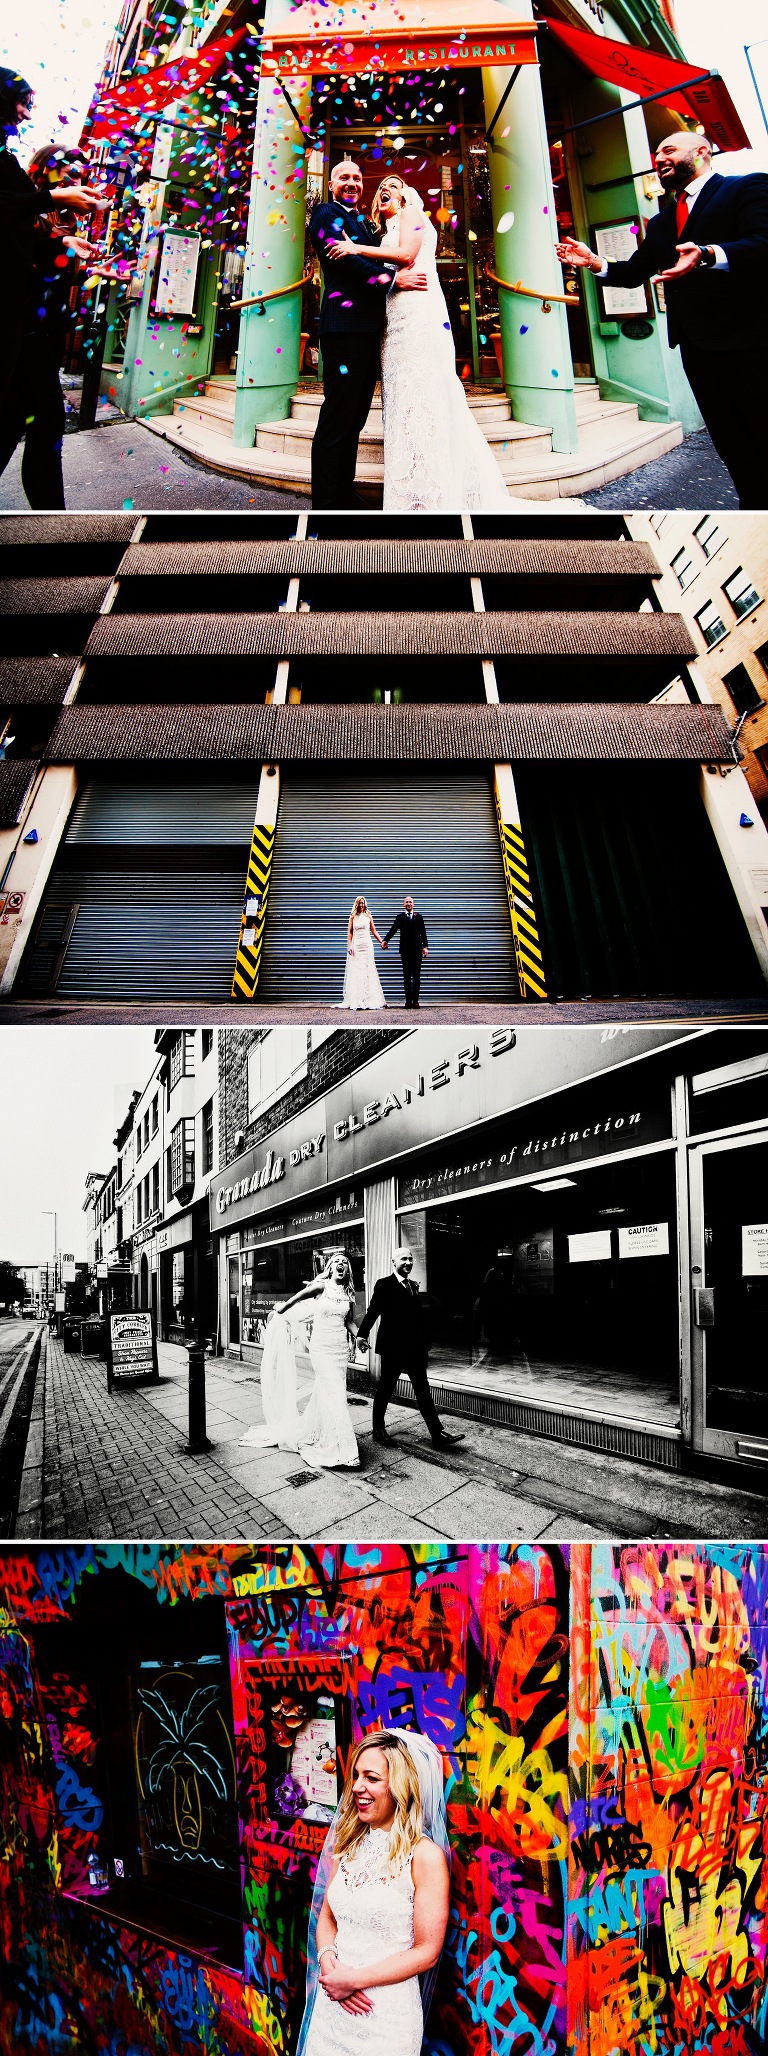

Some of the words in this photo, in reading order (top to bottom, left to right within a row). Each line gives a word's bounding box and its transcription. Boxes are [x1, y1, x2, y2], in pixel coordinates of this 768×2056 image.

[279, 54, 311, 67] BAR
[405, 43, 517, 61] RESTAURANT
[494, 791, 515, 911] LOADING
[513, 933, 527, 998] BAY
[216, 1150, 286, 1215] Granada
[290, 1134, 326, 1167] DRY
[333, 1029, 517, 1142] CLEANERS
[412, 1178, 434, 1190] Dry
[437, 1157, 493, 1180] cleaners
[499, 1146, 518, 1165] of
[522, 1111, 642, 1157] distinction
[314, 1211, 326, 1220] Dry
[328, 1201, 358, 1215] Cleaners
[628, 1226, 658, 1235] CAUTION
[114, 1341, 150, 1349] TRADITIONAL
